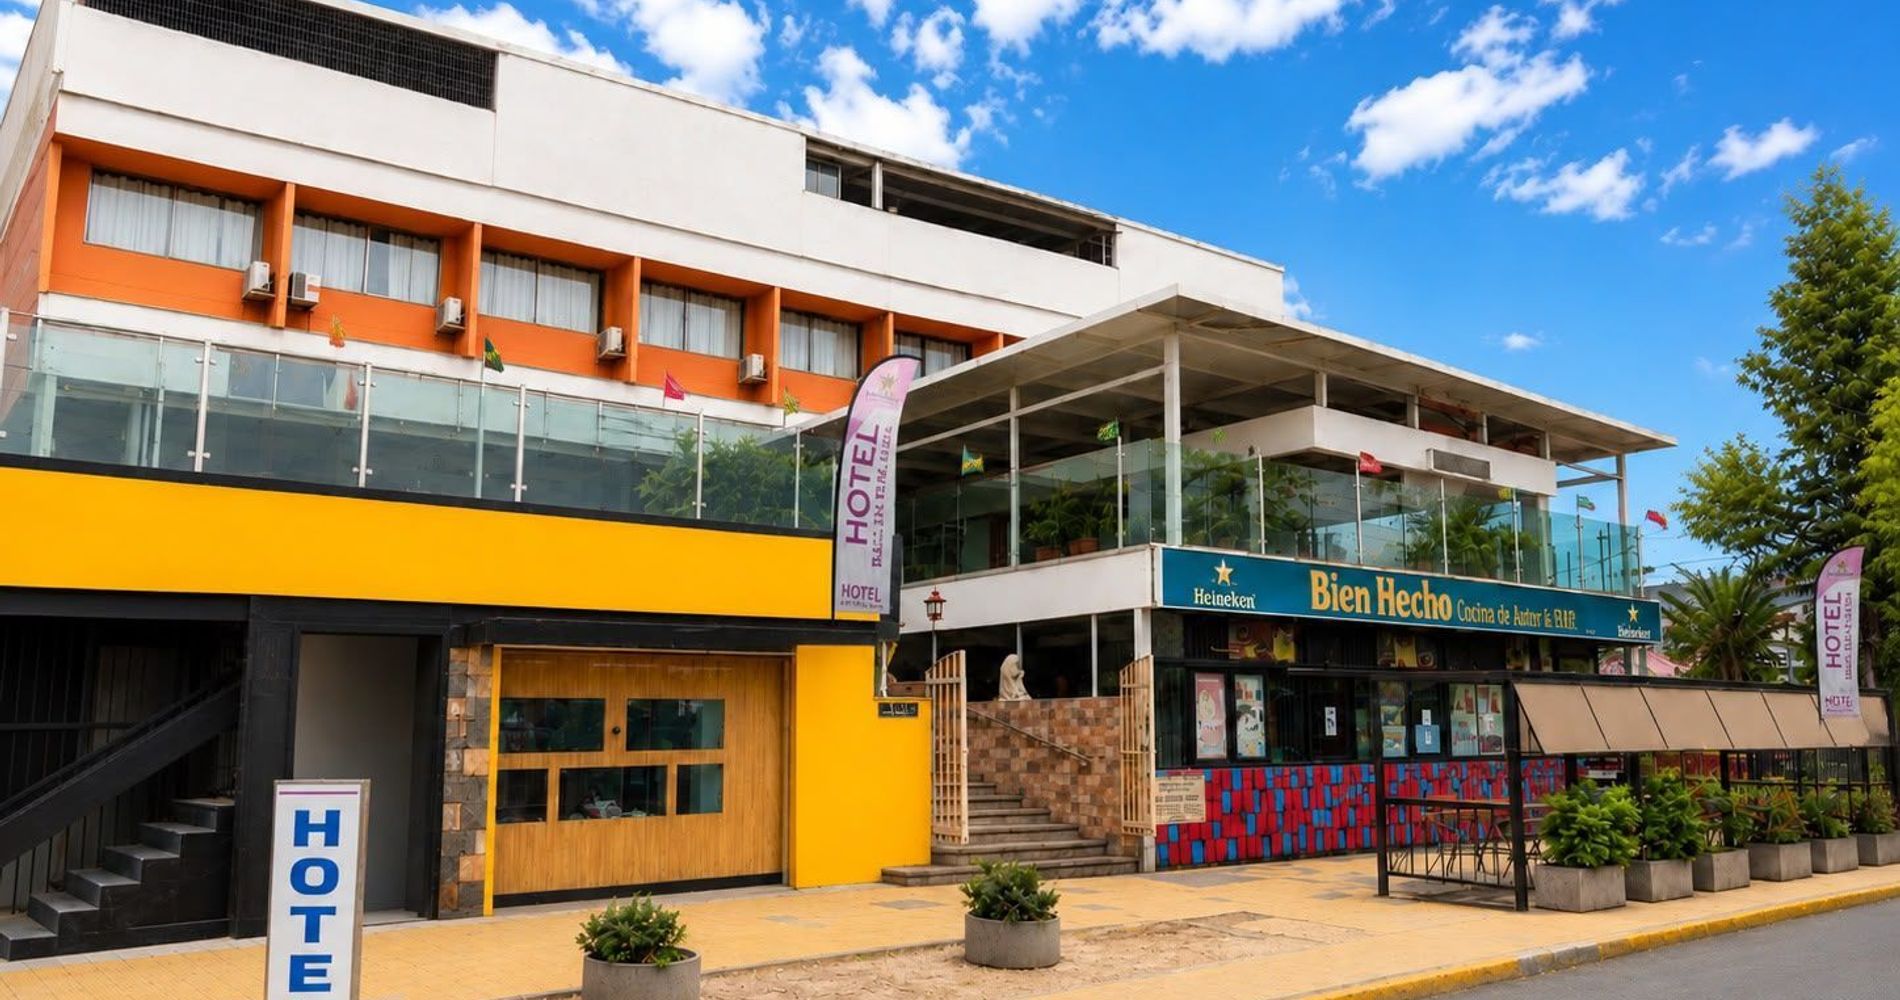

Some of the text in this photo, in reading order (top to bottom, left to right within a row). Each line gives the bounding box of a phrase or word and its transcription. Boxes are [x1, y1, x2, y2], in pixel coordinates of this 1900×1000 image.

[845, 424, 880, 545] HOTEL
[841, 583, 882, 603] HOTEL
[1193, 588, 1256, 609] Heineken
[1310, 569, 1371, 614] Bien
[1375, 575, 1453, 621] Hecho
[1456, 598, 1496, 624] Cocina
[1497, 603, 1510, 626] de
[1823, 592, 1842, 669] HOTEL
